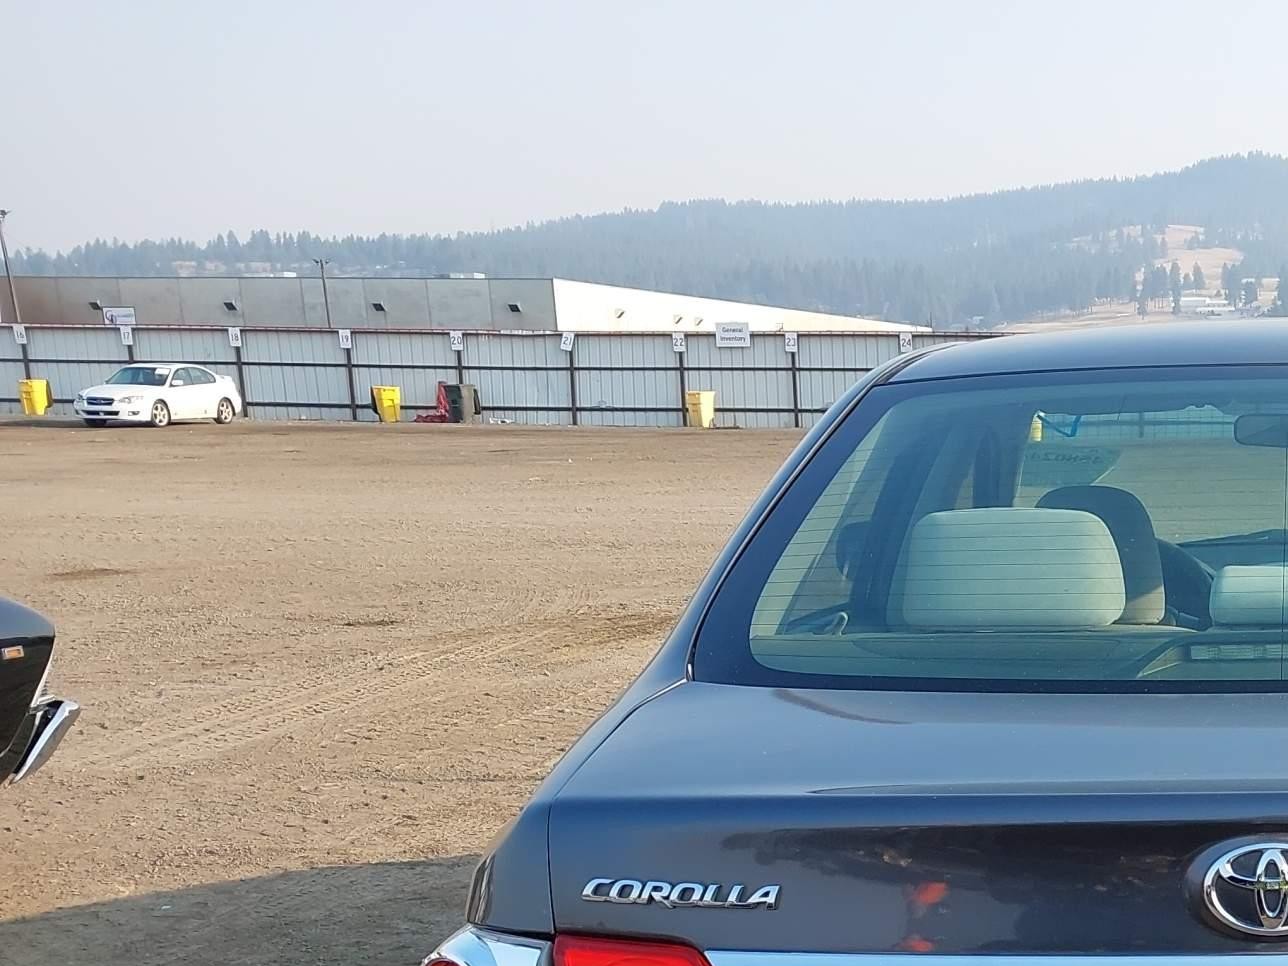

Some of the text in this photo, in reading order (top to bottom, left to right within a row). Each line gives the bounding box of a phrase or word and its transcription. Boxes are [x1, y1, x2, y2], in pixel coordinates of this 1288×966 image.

[230, 332, 239, 341] 18
[451, 336, 463, 345] 20
[563, 336, 573, 346] 21
[673, 337, 684, 346] 22
[786, 337, 796, 346] 23
[901, 338, 912, 347] 24
[582, 878, 781, 910] COROLLA
